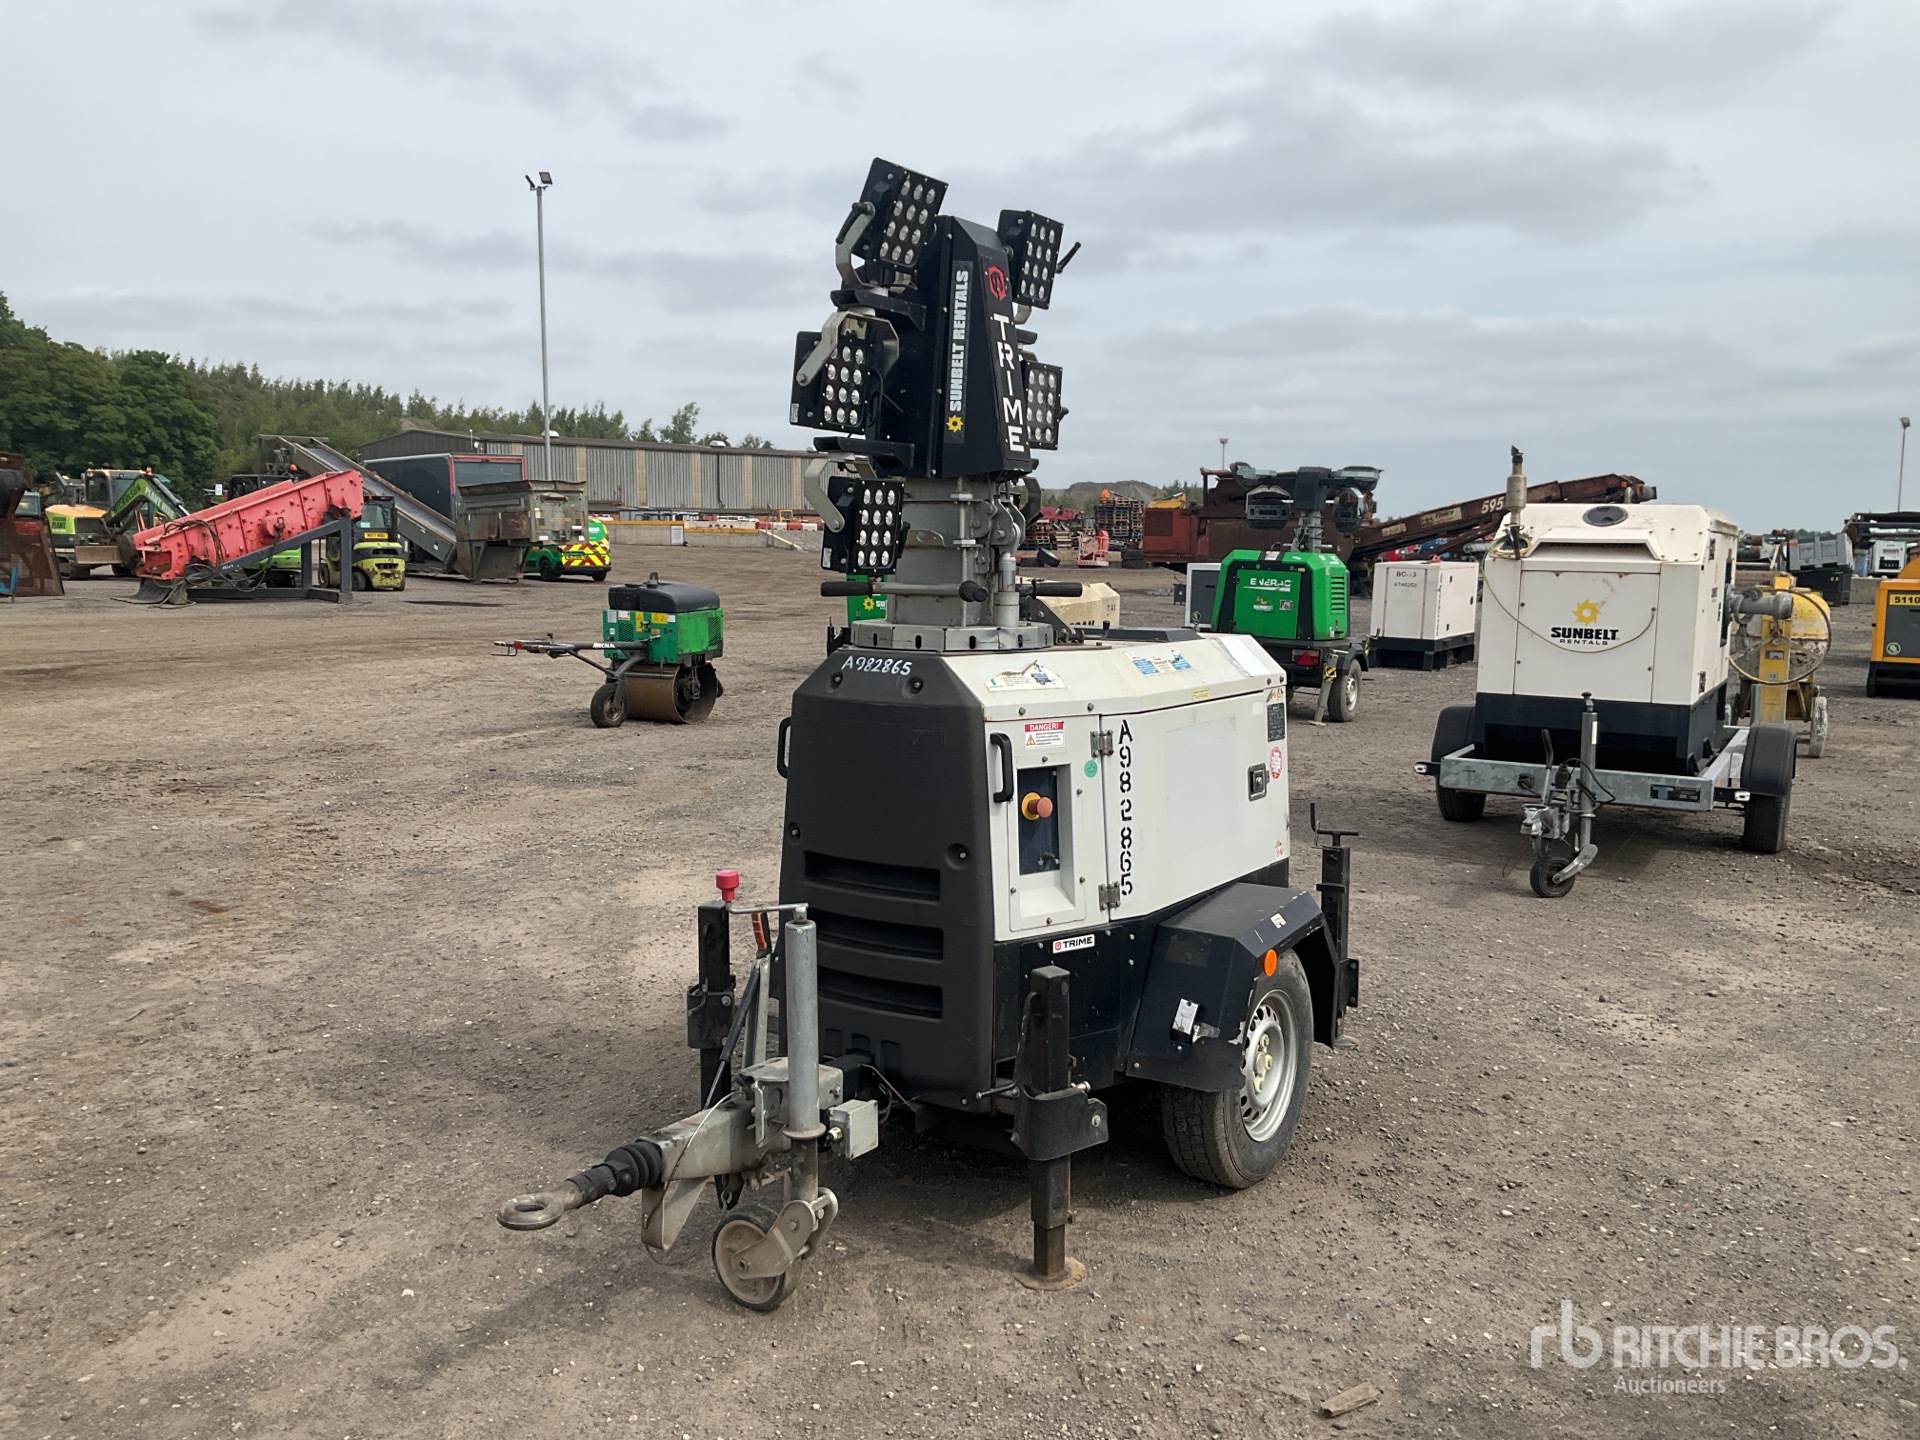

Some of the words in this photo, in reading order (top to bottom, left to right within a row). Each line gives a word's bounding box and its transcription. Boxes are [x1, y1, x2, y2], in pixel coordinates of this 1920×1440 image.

[952, 270, 969, 340] RENTALS
[950, 343, 965, 412] SUNBELT
[993, 313, 1025, 453] TRIME
[1481, 497, 1505, 514] 595
[1550, 626, 1619, 641] SUNBELT
[1559, 638, 1609, 646] RENTALS
[841, 655, 913, 676] A982865
[1029, 722, 1059, 731] DANGER!
[1062, 936, 1093, 949] TRIME
